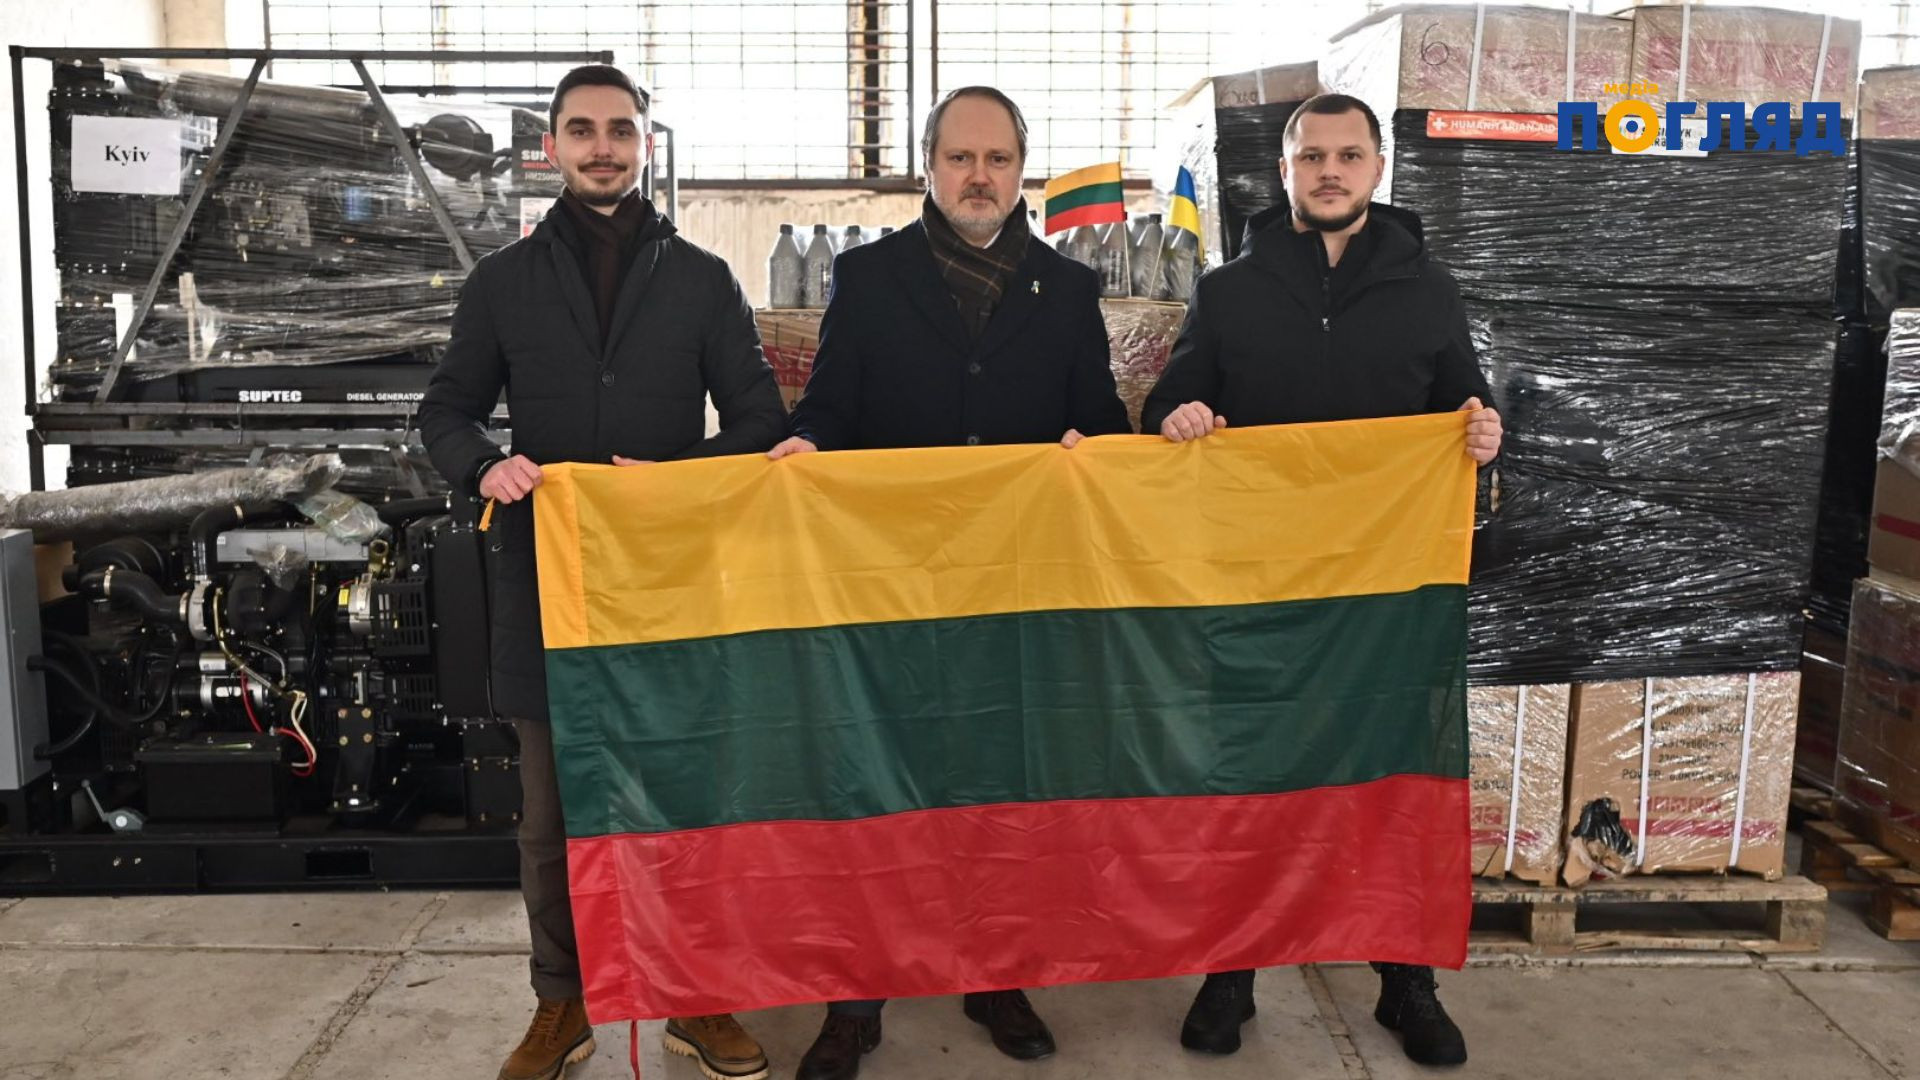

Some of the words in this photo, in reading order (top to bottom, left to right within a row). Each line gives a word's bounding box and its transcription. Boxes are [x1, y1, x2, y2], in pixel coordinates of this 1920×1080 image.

[1421, 23, 1449, 66] 6
[1450, 119, 1535, 132] HUMANITARIAN
[104, 144, 151, 167] Kyiv
[238, 390, 302, 403] SUPTEC
[346, 392, 375, 401] DIESEL
